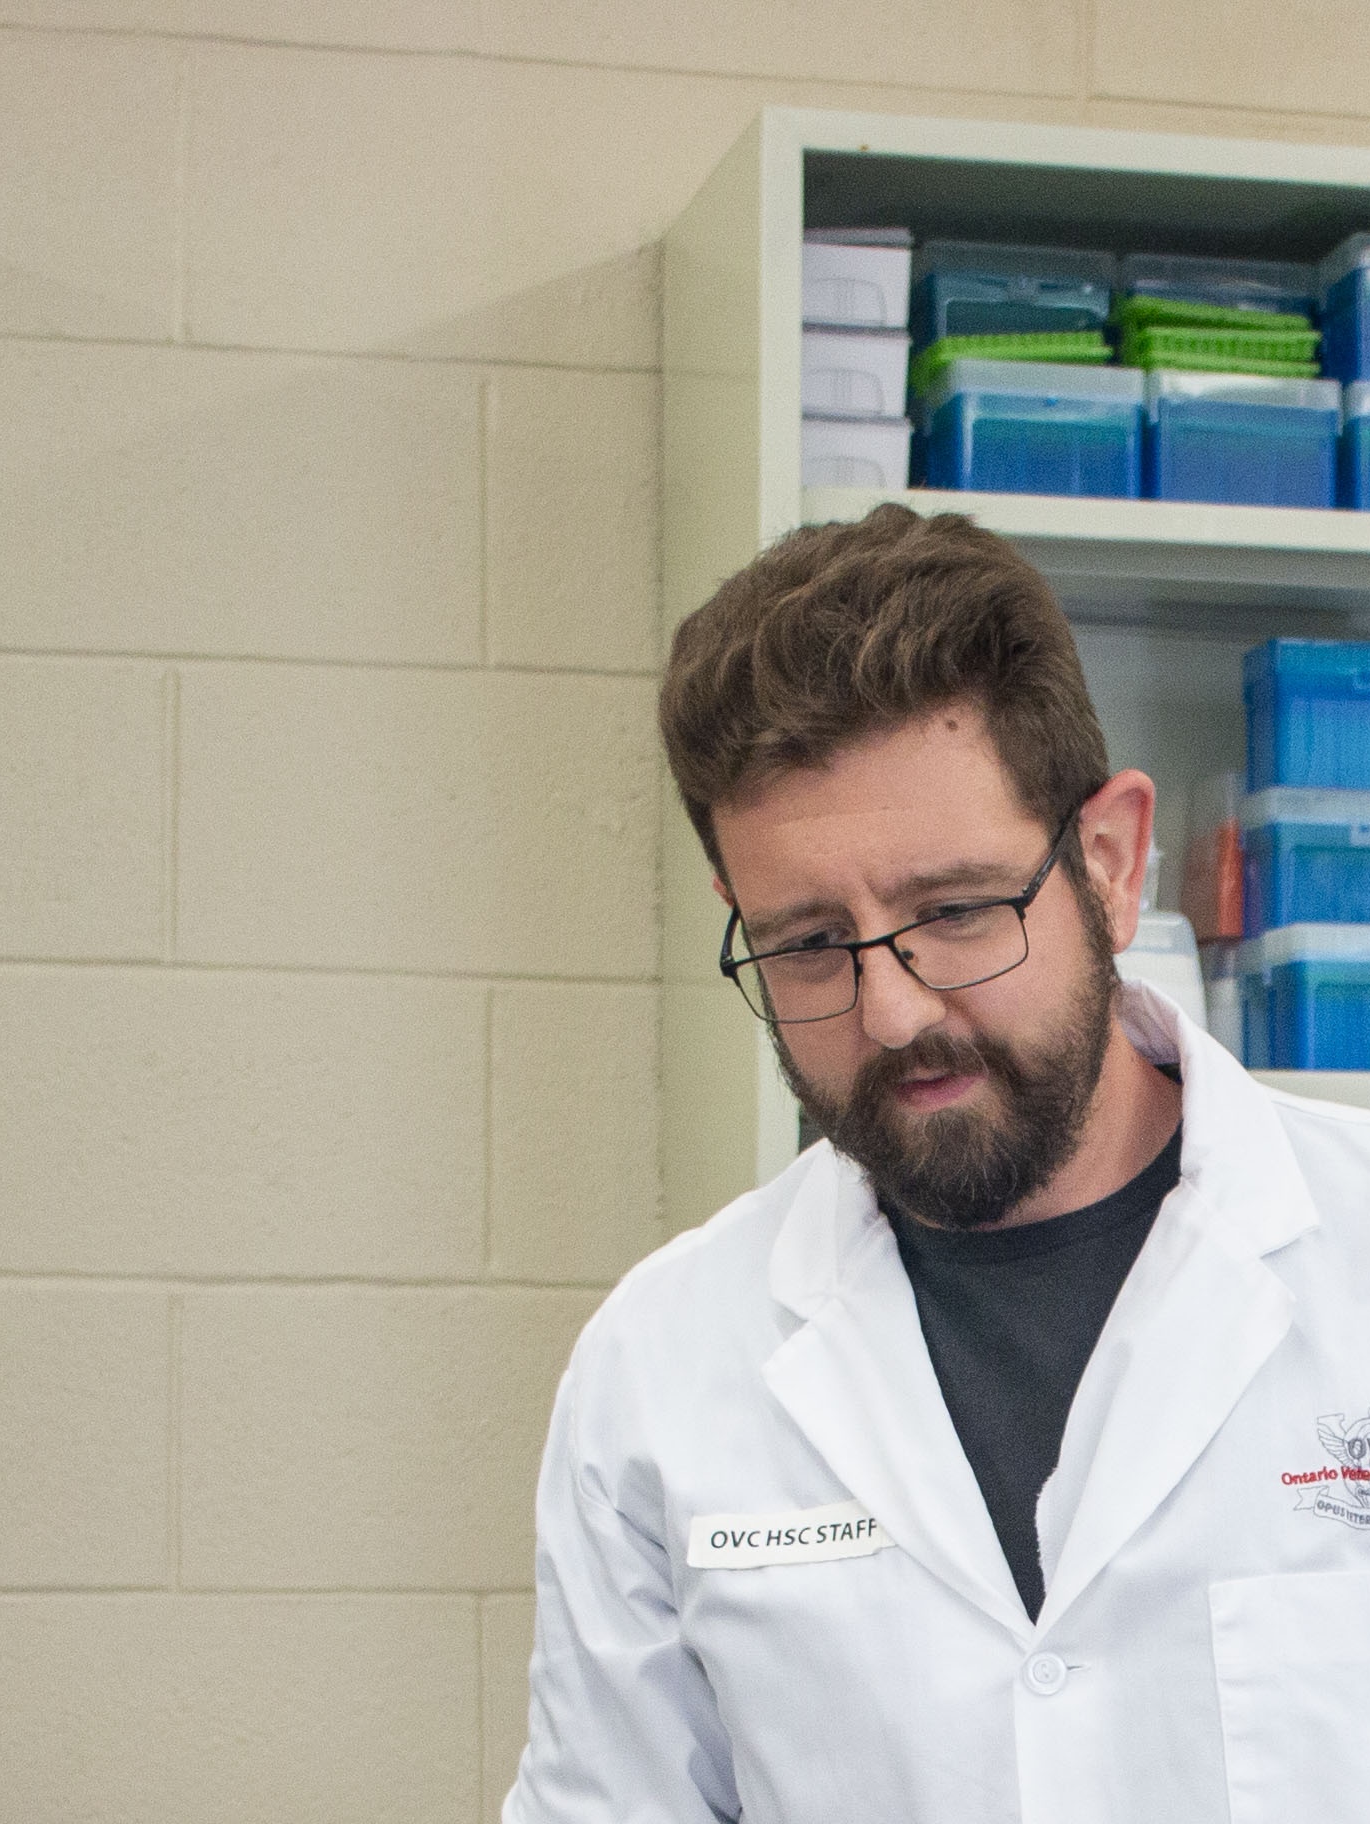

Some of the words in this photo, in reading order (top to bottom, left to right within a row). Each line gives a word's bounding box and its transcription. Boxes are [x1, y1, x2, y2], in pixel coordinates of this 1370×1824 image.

[1281, 1466, 1338, 1486] Ontario
[710, 1529, 761, 1549] OVC
[765, 1526, 811, 1547] HSC
[815, 1517, 878, 1544] STAFF
